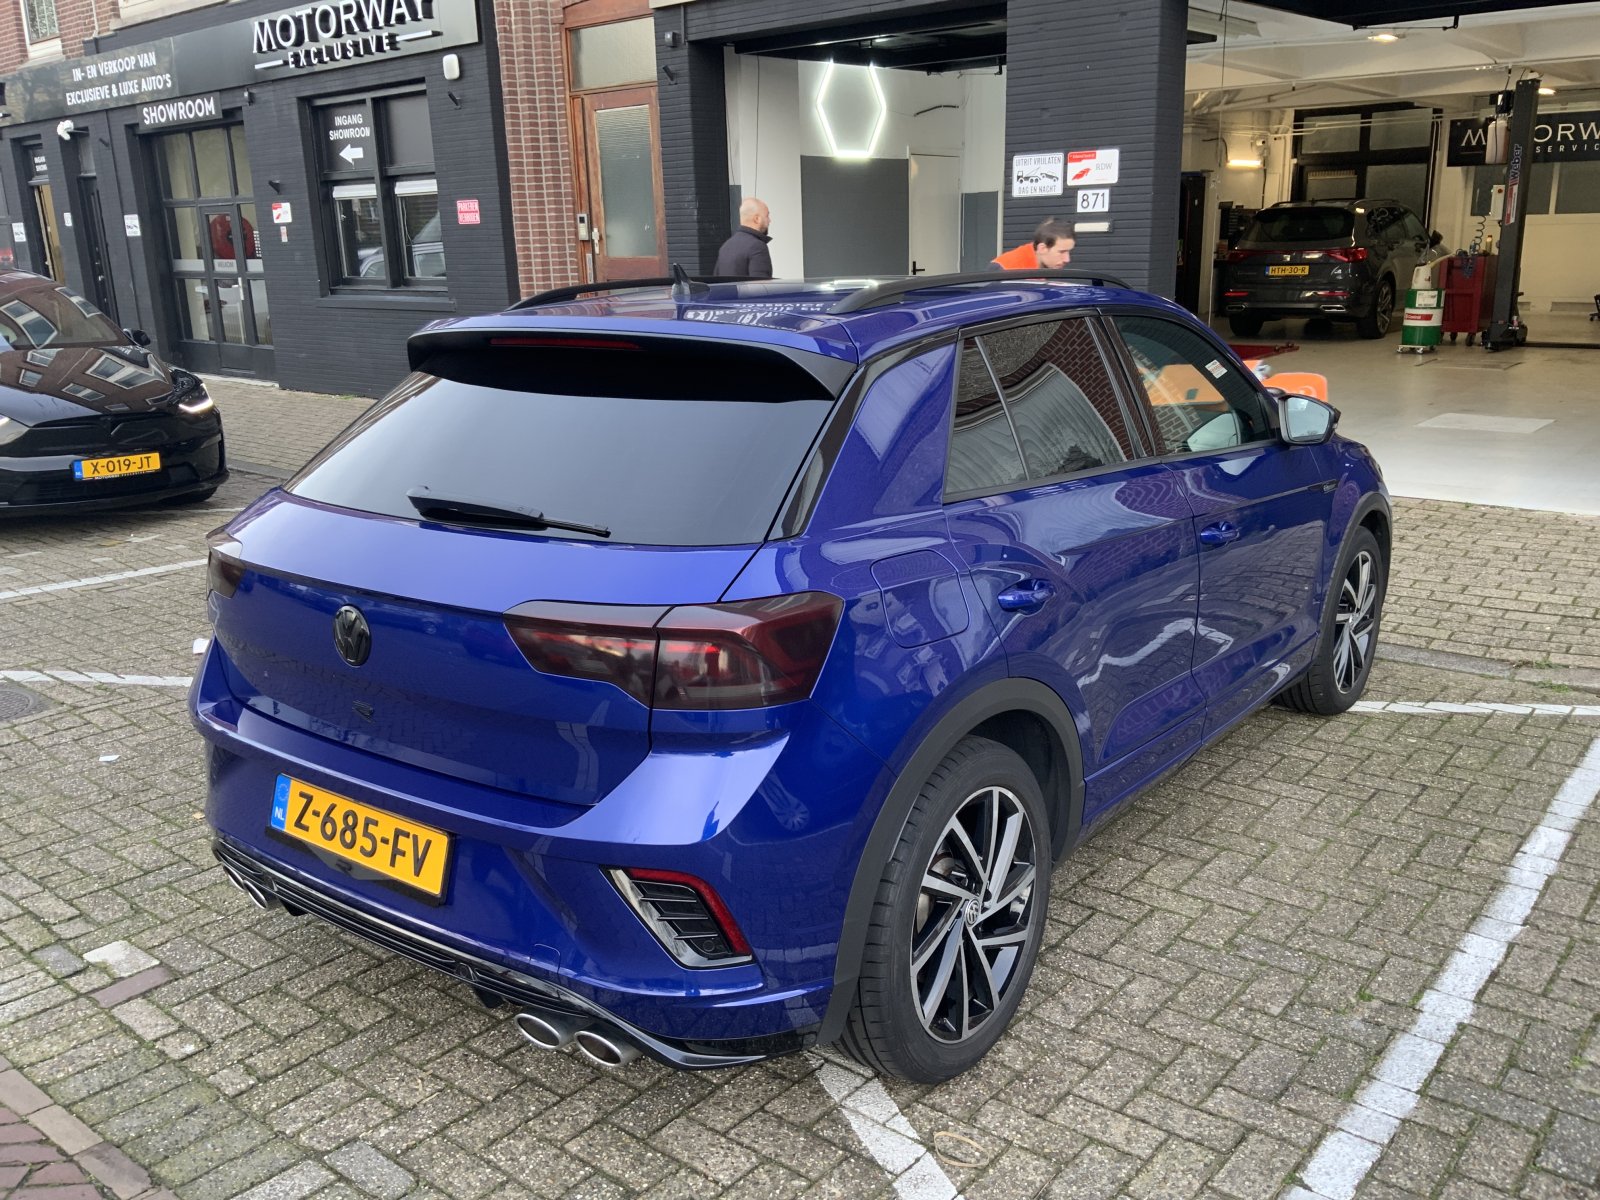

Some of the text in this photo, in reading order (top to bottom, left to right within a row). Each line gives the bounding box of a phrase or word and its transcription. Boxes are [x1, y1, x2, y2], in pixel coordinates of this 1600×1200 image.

[289, 32, 390, 68] EXCLUSIVE
[72, 51, 156, 81] IN- EN VERKOOP VAN
[66, 73, 172, 106] EXCLUSIEVE & LUXE AUTO'S
[142, 96, 215, 125] SHOWROOM
[334, 113, 363, 126] INGANG
[1095, 162, 1113, 171] RDW
[1510, 143, 1522, 181] Weber
[1031, 186, 1037, 194] EN
[1039, 185, 1057, 193] NACHT
[1080, 192, 1105, 209] 871
[90, 456, 152, 475] X-019-JT
[274, 806, 285, 822] NL
[293, 790, 433, 878] Z-685-FV
